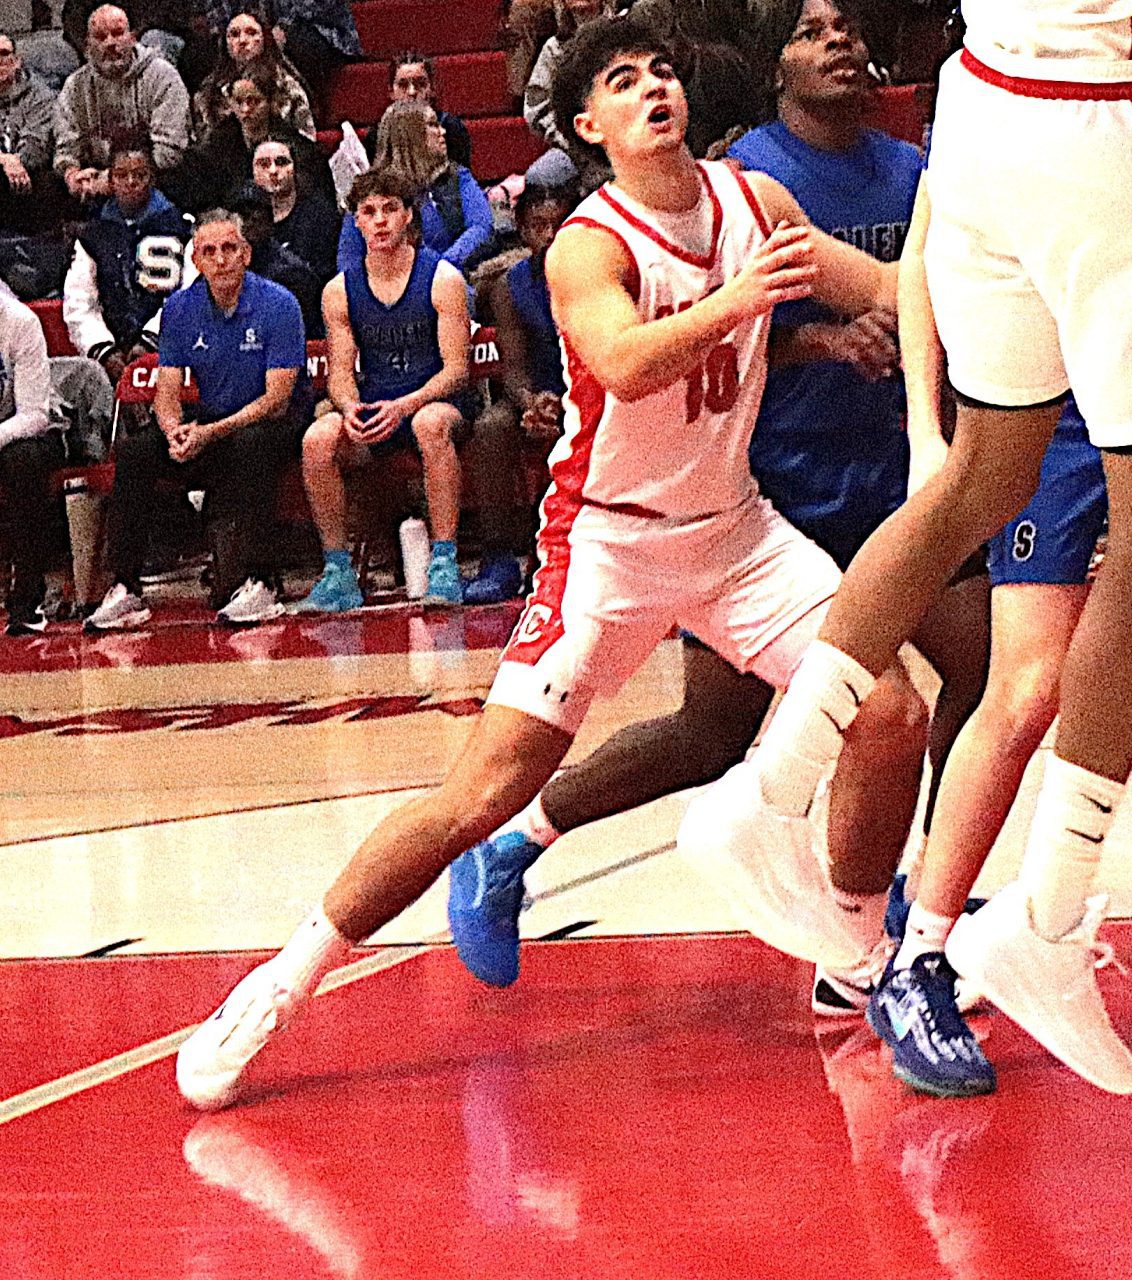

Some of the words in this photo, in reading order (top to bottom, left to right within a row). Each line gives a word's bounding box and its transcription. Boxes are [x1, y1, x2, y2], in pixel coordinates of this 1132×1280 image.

[136, 235, 184, 293] S
[684, 342, 741, 425] 10
[1012, 520, 1037, 562] S
